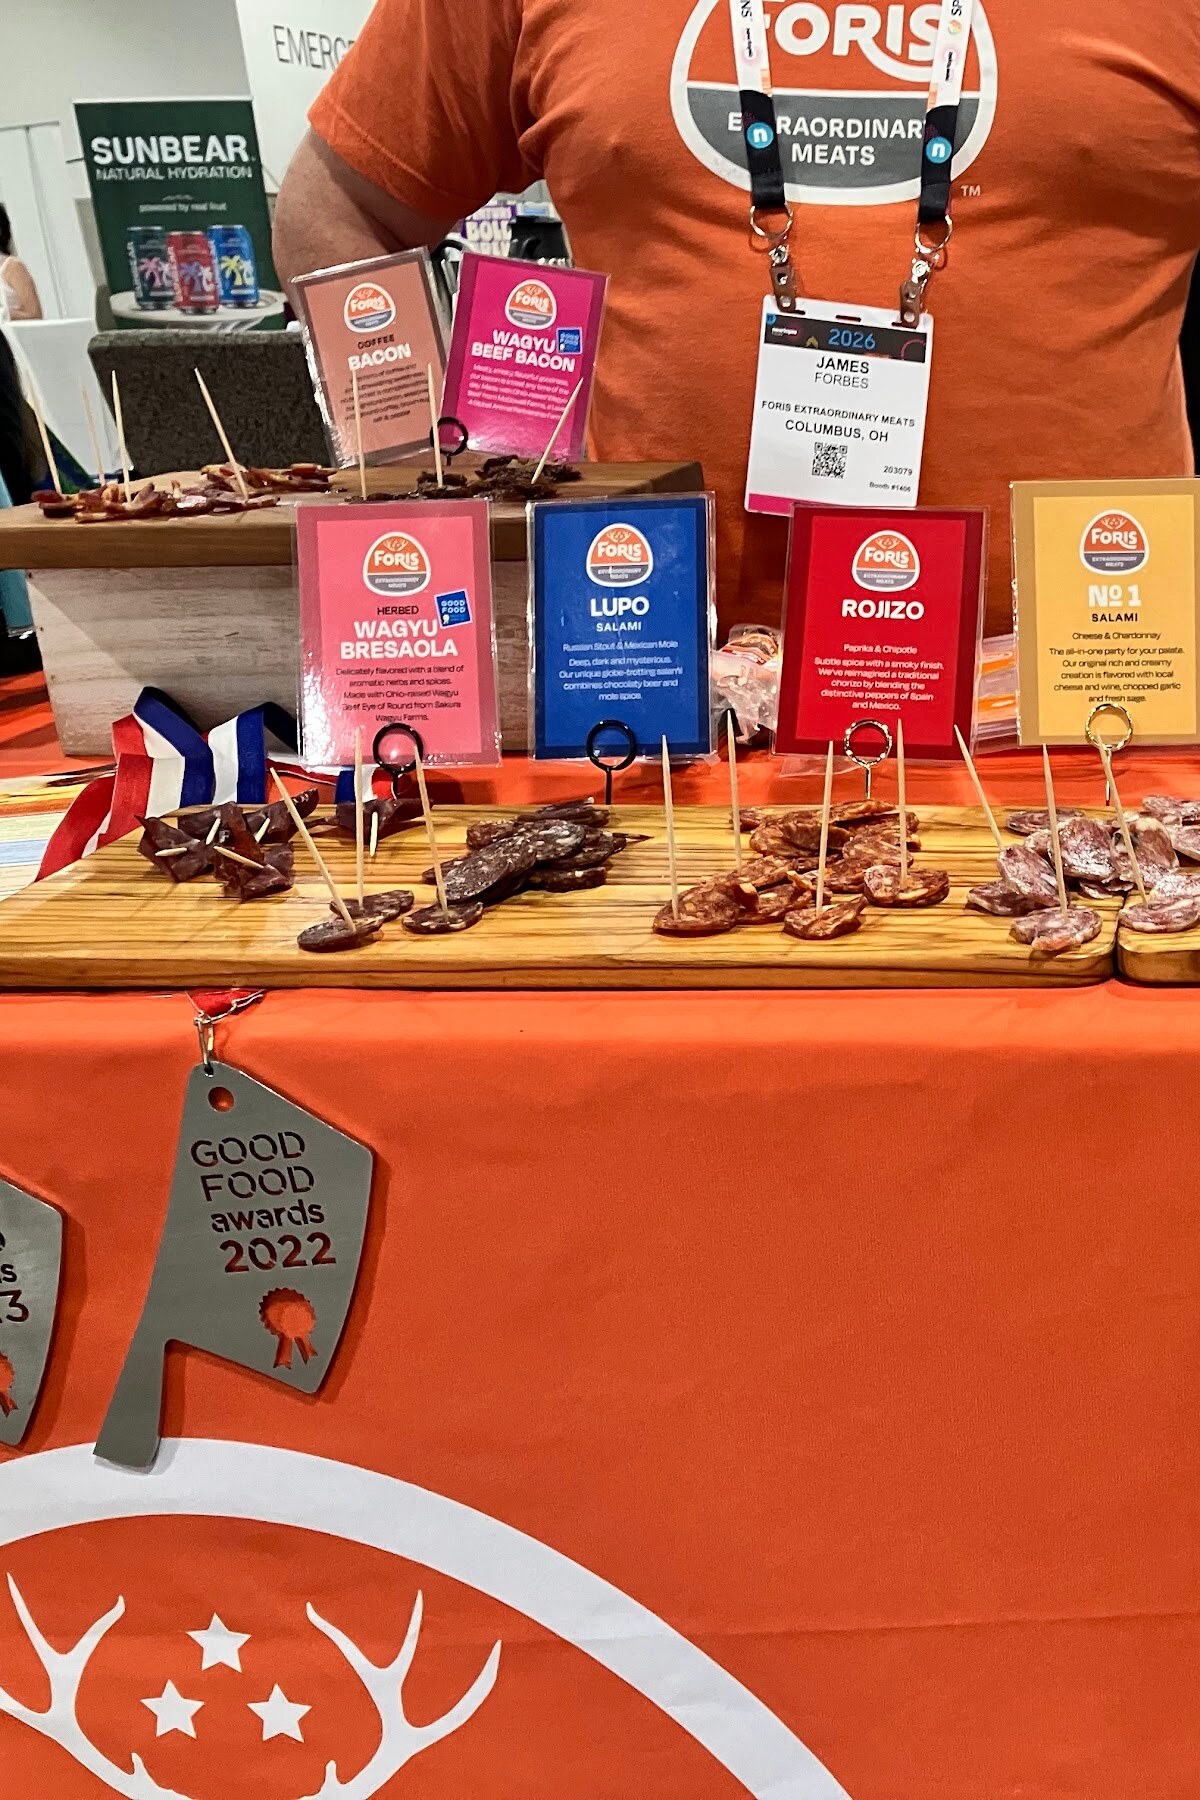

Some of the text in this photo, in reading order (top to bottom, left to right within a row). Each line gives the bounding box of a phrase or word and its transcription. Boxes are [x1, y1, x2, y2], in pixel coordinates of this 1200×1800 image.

[761, 0, 941, 82] ORIS
[728, 112, 926, 138] ERAORDINAR
[91, 135, 249, 164] SUNBEAR
[792, 144, 875, 165] MEATS
[96, 166, 253, 180] NATURAL HYDRATION
[961, 185, 981, 197] TM
[358, 334, 394, 349] COFFEE
[492, 330, 555, 353] WAGYU
[828, 329, 876, 349] 2026
[348, 344, 411, 371] BACON
[472, 342, 575, 372] BEEF BACON
[817, 357, 869, 373] JAMES
[815, 372, 869, 389] FORBES
[762, 401, 914, 427] FORIS EXTRAORDINARY MEATS
[786, 420, 888, 442] COLUMBUS, OH
[884, 466, 912, 476] 203079
[1091, 528, 1137, 549] FORIS
[374, 550, 419, 570] FORIS
[597, 541, 641, 561] FORIS
[864, 547, 909, 568] FORIS
[377, 605, 419, 615] HERBED
[591, 596, 649, 617] LUPO
[841, 599, 924, 620] ROJIZO
[596, 622, 641, 632] SALAMI
[1092, 613, 1138, 622] SALAMI
[354, 618, 438, 638] WAGYU
[1112, 632, 1161, 640] Chardonnay
[340, 639, 458, 659] BRESAOLA
[563, 644, 593, 652] Russian
[616, 641, 623, 650] &
[624, 641, 657, 649] Mexican
[844, 644, 873, 652] Paprika
[882, 646, 917, 654] Chipotle
[1105, 647, 1125, 656] party
[1139, 648, 1156, 656] your
[815, 657, 841, 665] Subtle
[842, 659, 865, 667] spice
[891, 661, 918, 670] smoky
[920, 661, 944, 670] finish.
[818, 668, 843, 676] We've
[844, 669, 890, 678] reimagined
[898, 671, 939, 679] traditional
[1079, 659, 1107, 668] original
[1141, 659, 1172, 667] creamy
[821, 690, 863, 698] distinctive
[865, 692, 899, 700] peppers
[910, 693, 933, 701] Spain
[863, 680, 874, 689] by
[875, 681, 909, 691] blending
[911, 682, 925, 690] the
[869, 702, 900, 710] Mexico.
[191, 1132, 305, 1167] GOOD
[201, 1166, 314, 1201] FOOD
[212, 1199, 324, 1232] awards
[219, 1232, 336, 1273] 2022
